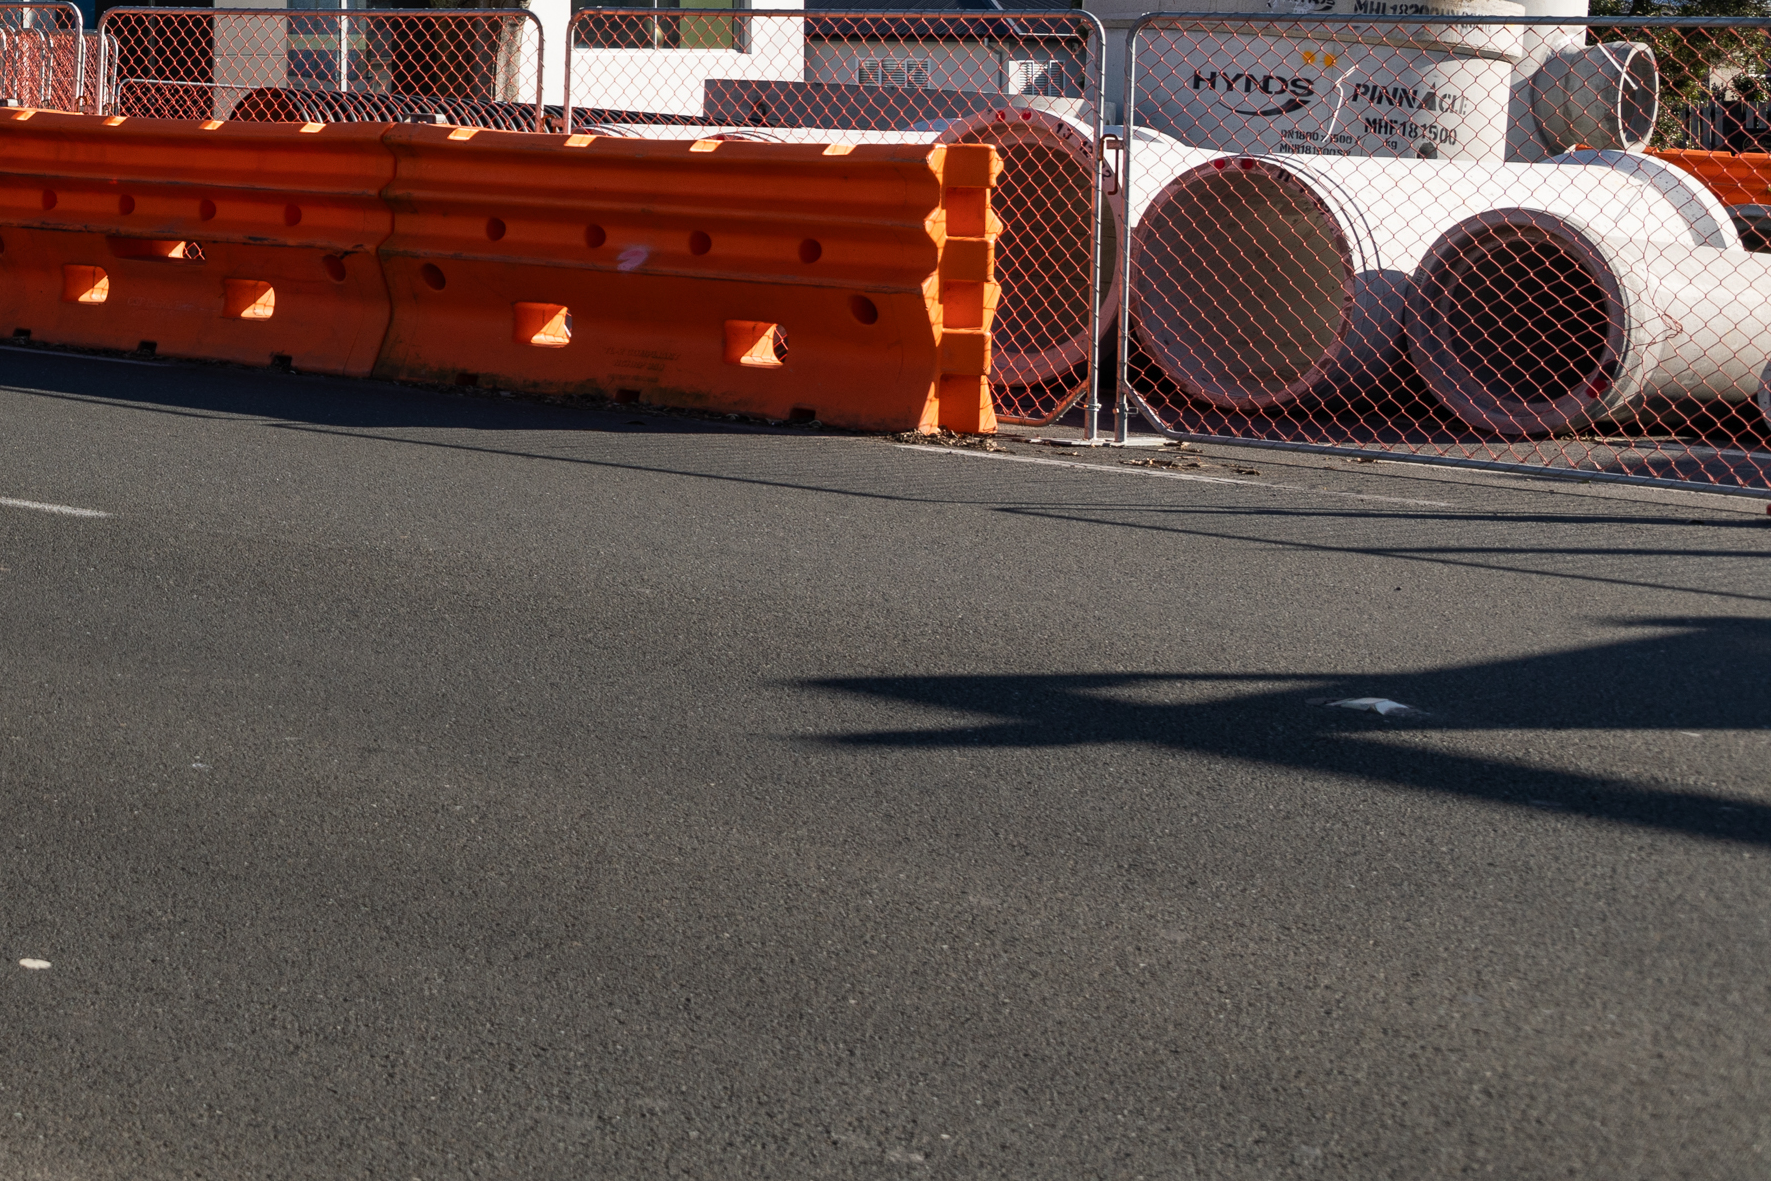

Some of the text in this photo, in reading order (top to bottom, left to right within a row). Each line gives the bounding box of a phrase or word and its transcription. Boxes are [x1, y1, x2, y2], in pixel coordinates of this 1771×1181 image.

[1193, 69, 1469, 116] HYNDS PINNACLE
[1385, 137, 1398, 150] kg
